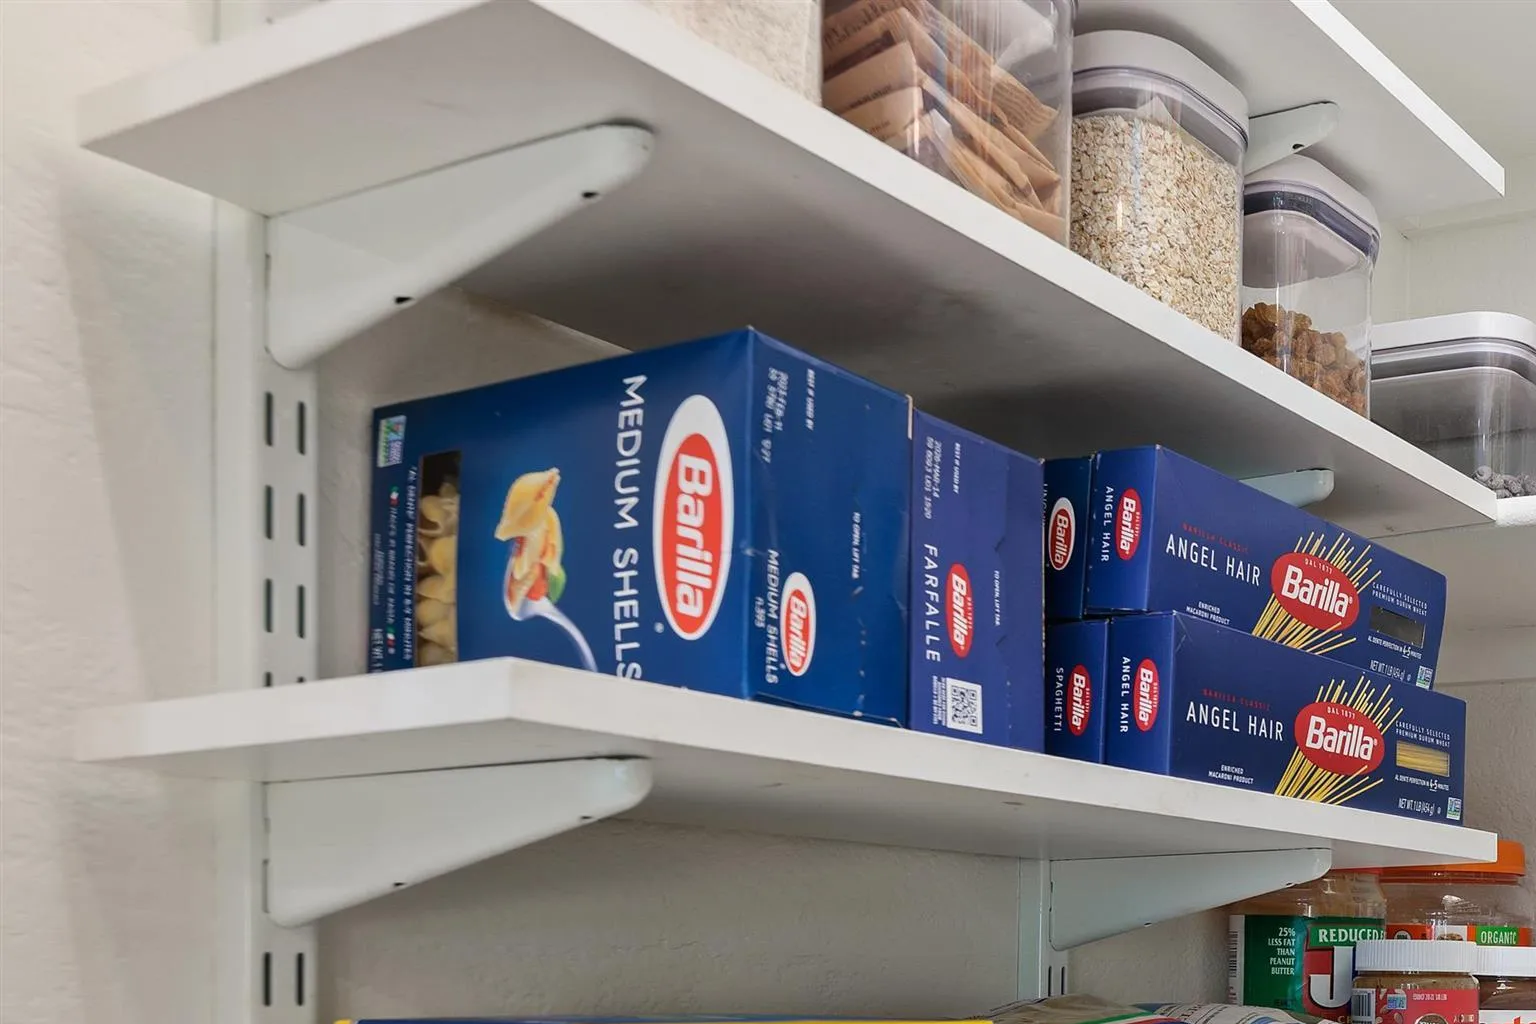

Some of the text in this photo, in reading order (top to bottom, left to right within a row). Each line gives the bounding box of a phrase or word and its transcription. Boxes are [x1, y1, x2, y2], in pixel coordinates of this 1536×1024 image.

[612, 375, 648, 682] MEDIUM SHELLS
[675, 453, 713, 618] Barilla
[1055, 514, 1068, 564] Barilla
[1101, 486, 1114, 562] ANGEL HAIR
[1120, 497, 1136, 555] Barilla
[1166, 534, 1260, 586] ANGEL HAIR
[924, 543, 941, 662] FARFALLE
[951, 572, 968, 647] Barilla
[1186, 606, 1230, 625] MACARONI PRODUCT
[1198, 601, 1220, 614] ENRICHED
[1281, 564, 1350, 618] Barilla
[765, 550, 781, 685] MEDIUM SHELLS
[789, 598, 807, 668] Barilla
[1053, 668, 1064, 731] SPAGHETTI
[1072, 673, 1086, 728] Barilla
[1120, 657, 1131, 733] ANGEL HAIR
[1139, 668, 1153, 724] Barilla
[1186, 702, 1284, 741] ANGEL HAIR
[1306, 716, 1373, 761] Barilla
[1396, 721, 1450, 741] CAREFULLY SELECTED
[1208, 771, 1253, 785] MACARONI PRODUCT
[1221, 764, 1243, 775] ENRICHED
[1268, 938, 1295, 946] LESS FAT
[1277, 948, 1295, 956] THAN
[1278, 927, 1295, 937] 25%
[1319, 928, 1379, 943] REDUCED
[1481, 930, 1517, 945] ORGANIC
[1270, 958, 1295, 966] PEANUT
[1271, 967, 1295, 976] BUTTER
